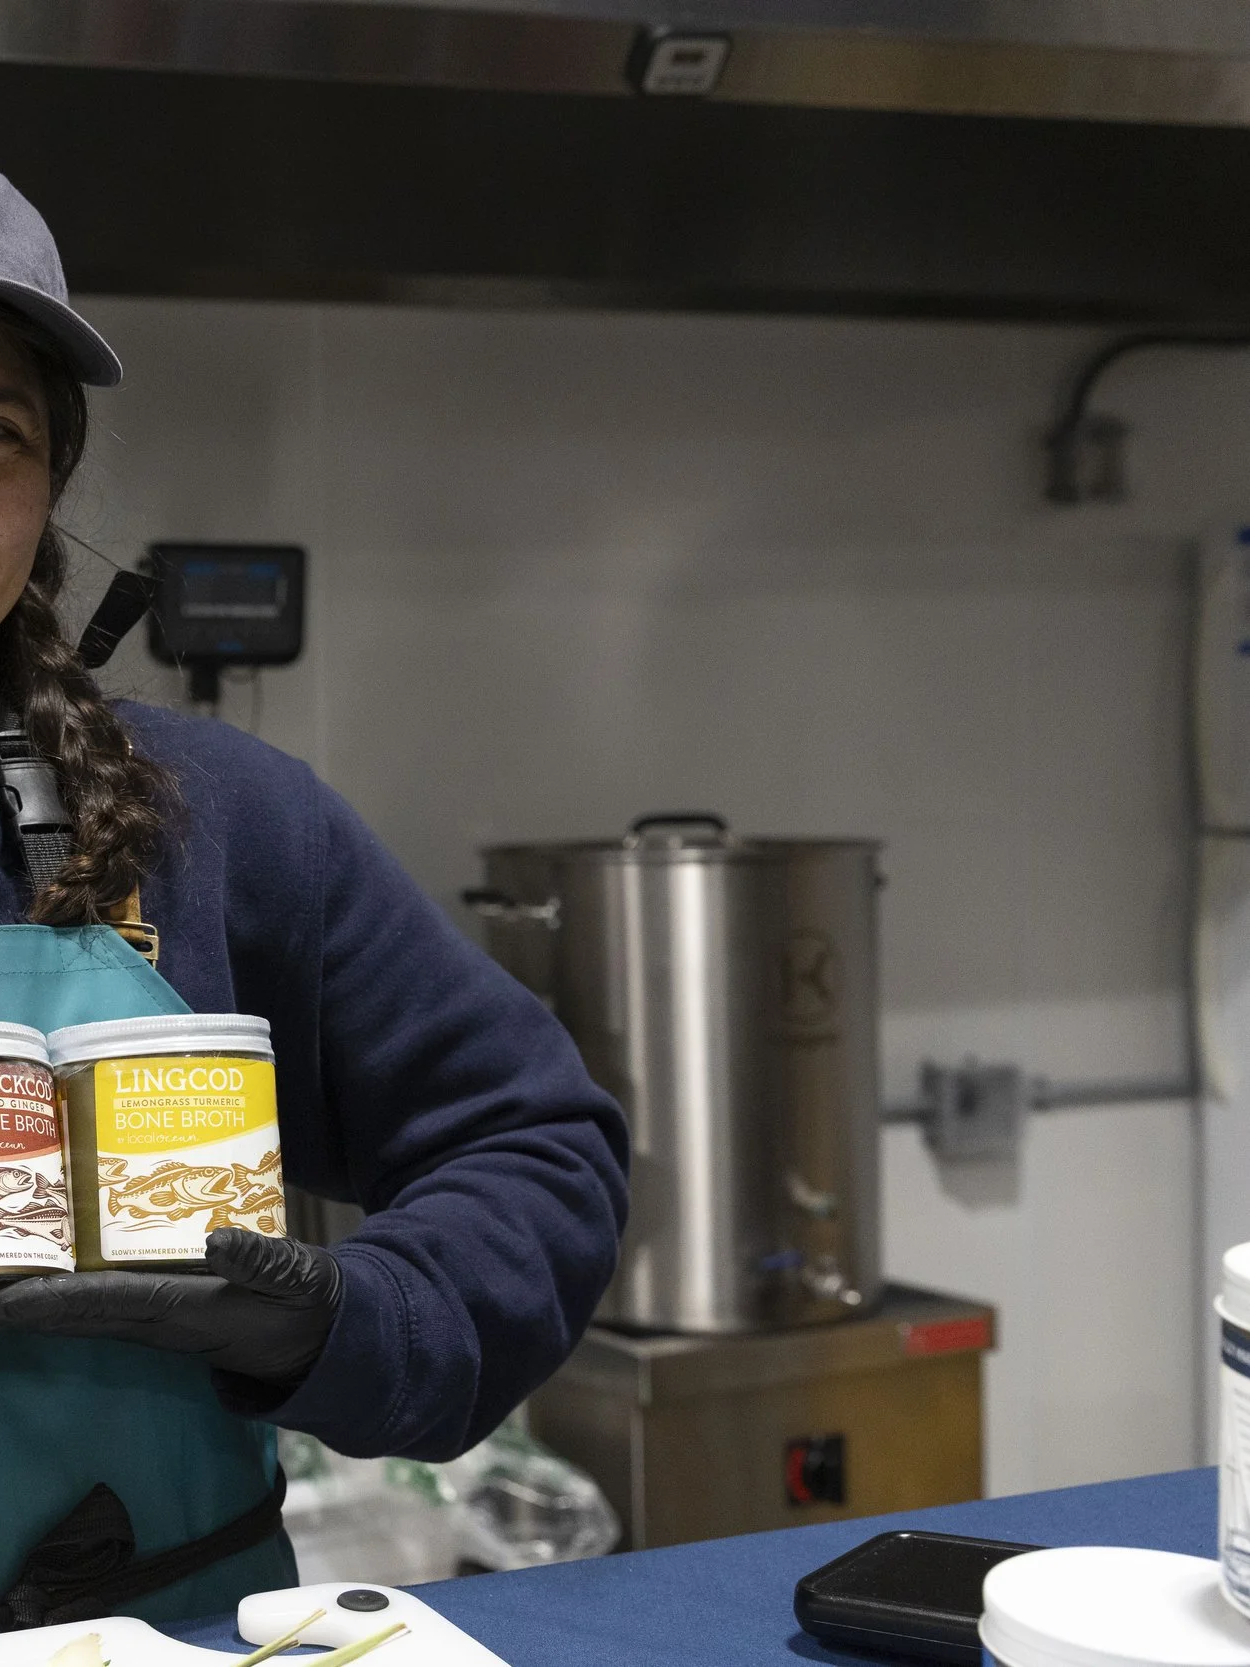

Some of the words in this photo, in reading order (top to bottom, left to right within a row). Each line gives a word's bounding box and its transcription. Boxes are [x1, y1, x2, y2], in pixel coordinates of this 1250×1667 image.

[115, 1067, 244, 1093] LINGCOD
[10, 1101, 45, 1113] GINGER
[121, 1098, 190, 1108] LEMONGRASS
[193, 1098, 240, 1106] TURMERIC
[115, 1111, 175, 1130] BONE
[181, 1109, 245, 1129] BROTH
[15, 1114, 56, 1138] BROTH
[34, 1252, 44, 1260] THE
[111, 1249, 137, 1257] SLOWLY
